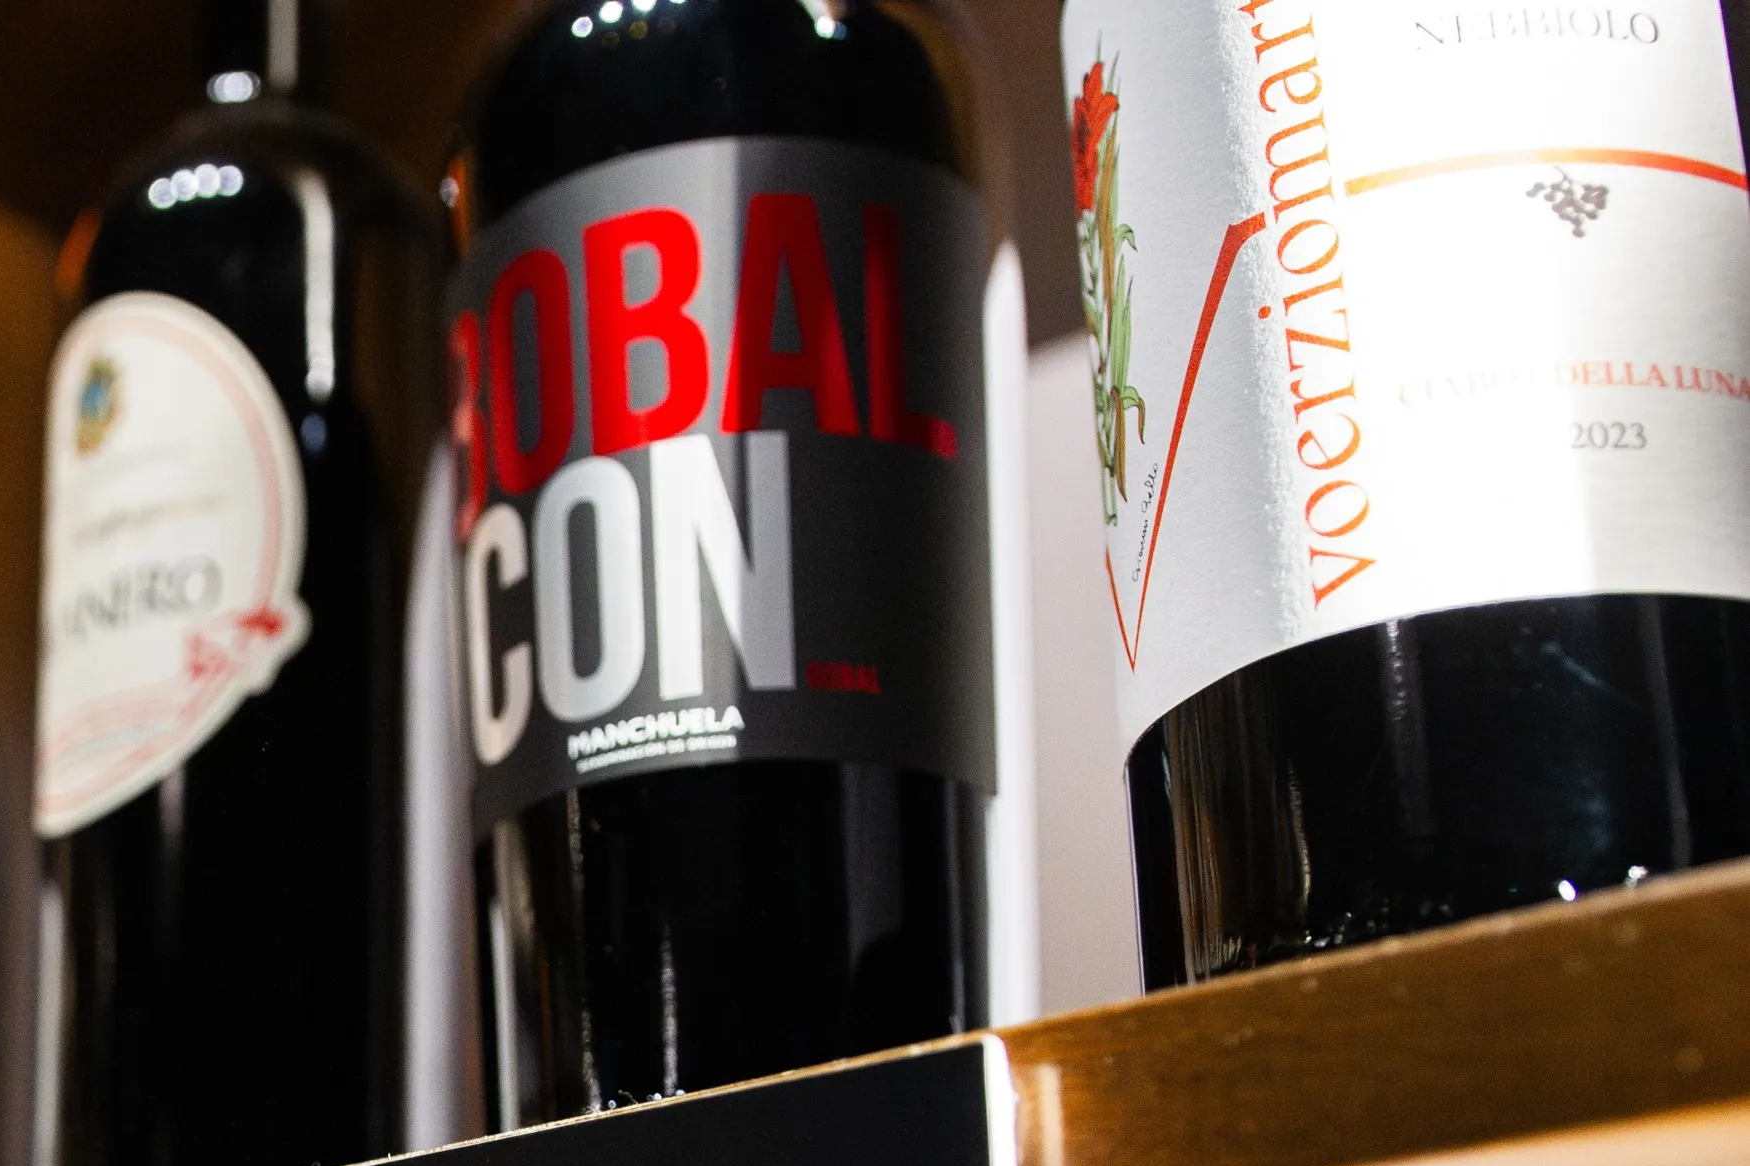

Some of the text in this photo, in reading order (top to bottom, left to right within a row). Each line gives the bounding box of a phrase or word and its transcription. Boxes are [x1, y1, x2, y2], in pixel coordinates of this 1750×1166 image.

[1414, 7, 1661, 50] NEBBIOLO
[1237, 0, 1378, 607] voerziomar
[1555, 360, 1669, 390] DELLA
[1570, 420, 1648, 451] 2023
[567, 706, 746, 761] MANCHUELA
